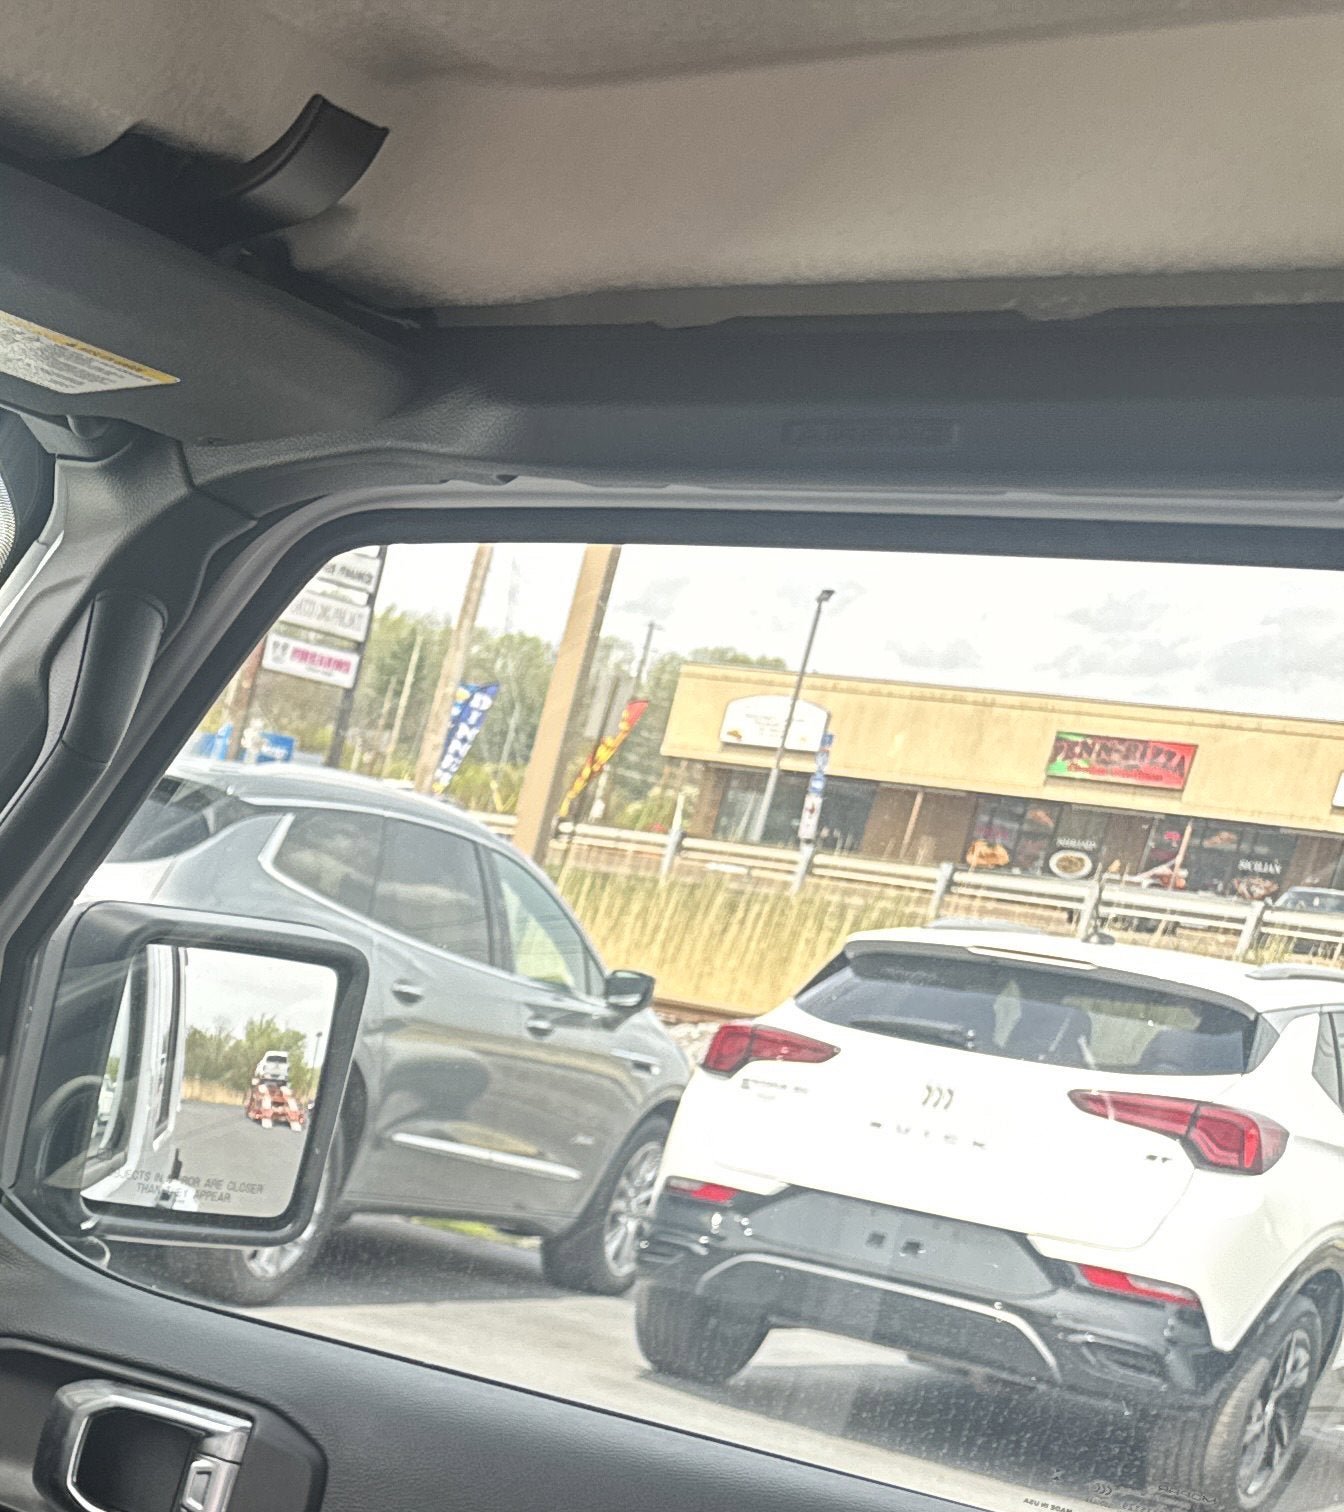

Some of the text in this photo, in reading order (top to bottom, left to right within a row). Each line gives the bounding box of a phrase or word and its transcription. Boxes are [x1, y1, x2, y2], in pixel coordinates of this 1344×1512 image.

[204, 1179, 224, 1190] ARE
[226, 1180, 265, 1194] CLOSER
[193, 1190, 231, 1203] APPEAR
